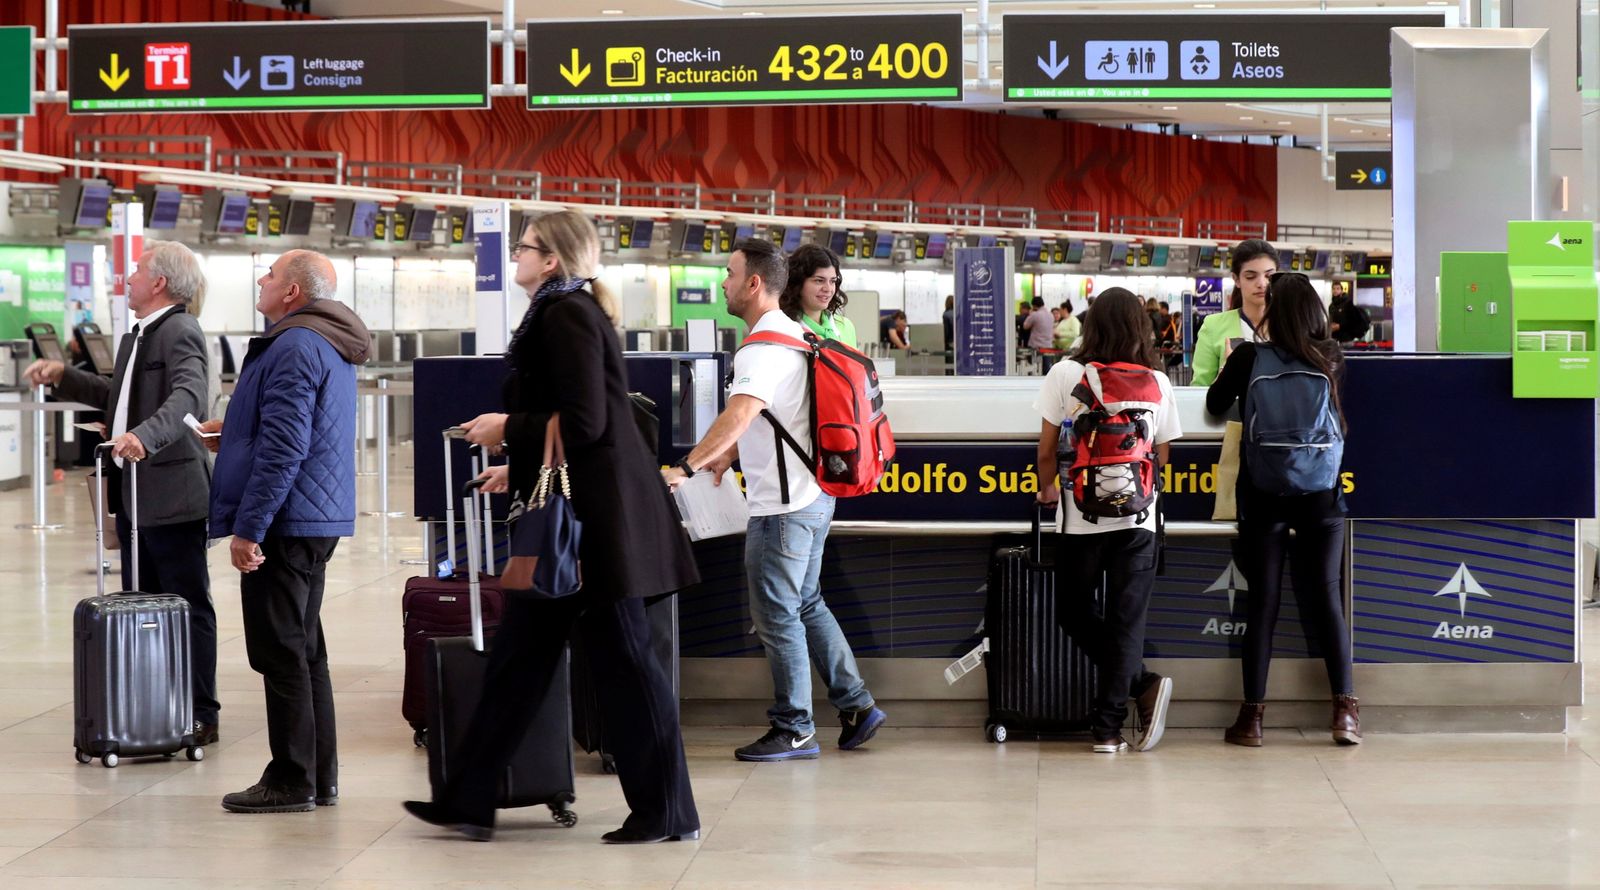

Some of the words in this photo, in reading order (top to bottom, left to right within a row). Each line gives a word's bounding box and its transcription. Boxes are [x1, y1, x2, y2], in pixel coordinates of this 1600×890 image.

[148, 46, 188, 55] Terminal
[656, 47, 721, 63] Check-in
[850, 47, 865, 61] to
[1231, 42, 1280, 58] Toilets
[146, 54, 189, 85] T1
[303, 58, 324, 69] Left
[324, 58, 365, 71] luggage
[768, 45, 848, 82] 432
[867, 42, 949, 80] 400
[656, 65, 758, 84] Facturación
[851, 65, 863, 80] a
[1231, 61, 1284, 79] Aseos
[303, 73, 363, 88] Consigna
[1209, 291, 1221, 303] WFS
[871, 463, 967, 494] dolfo
[979, 464, 1039, 493] Suá
[1159, 463, 1217, 494] drid
[1201, 618, 1247, 636] Aen
[1432, 621, 1494, 639] Aena
